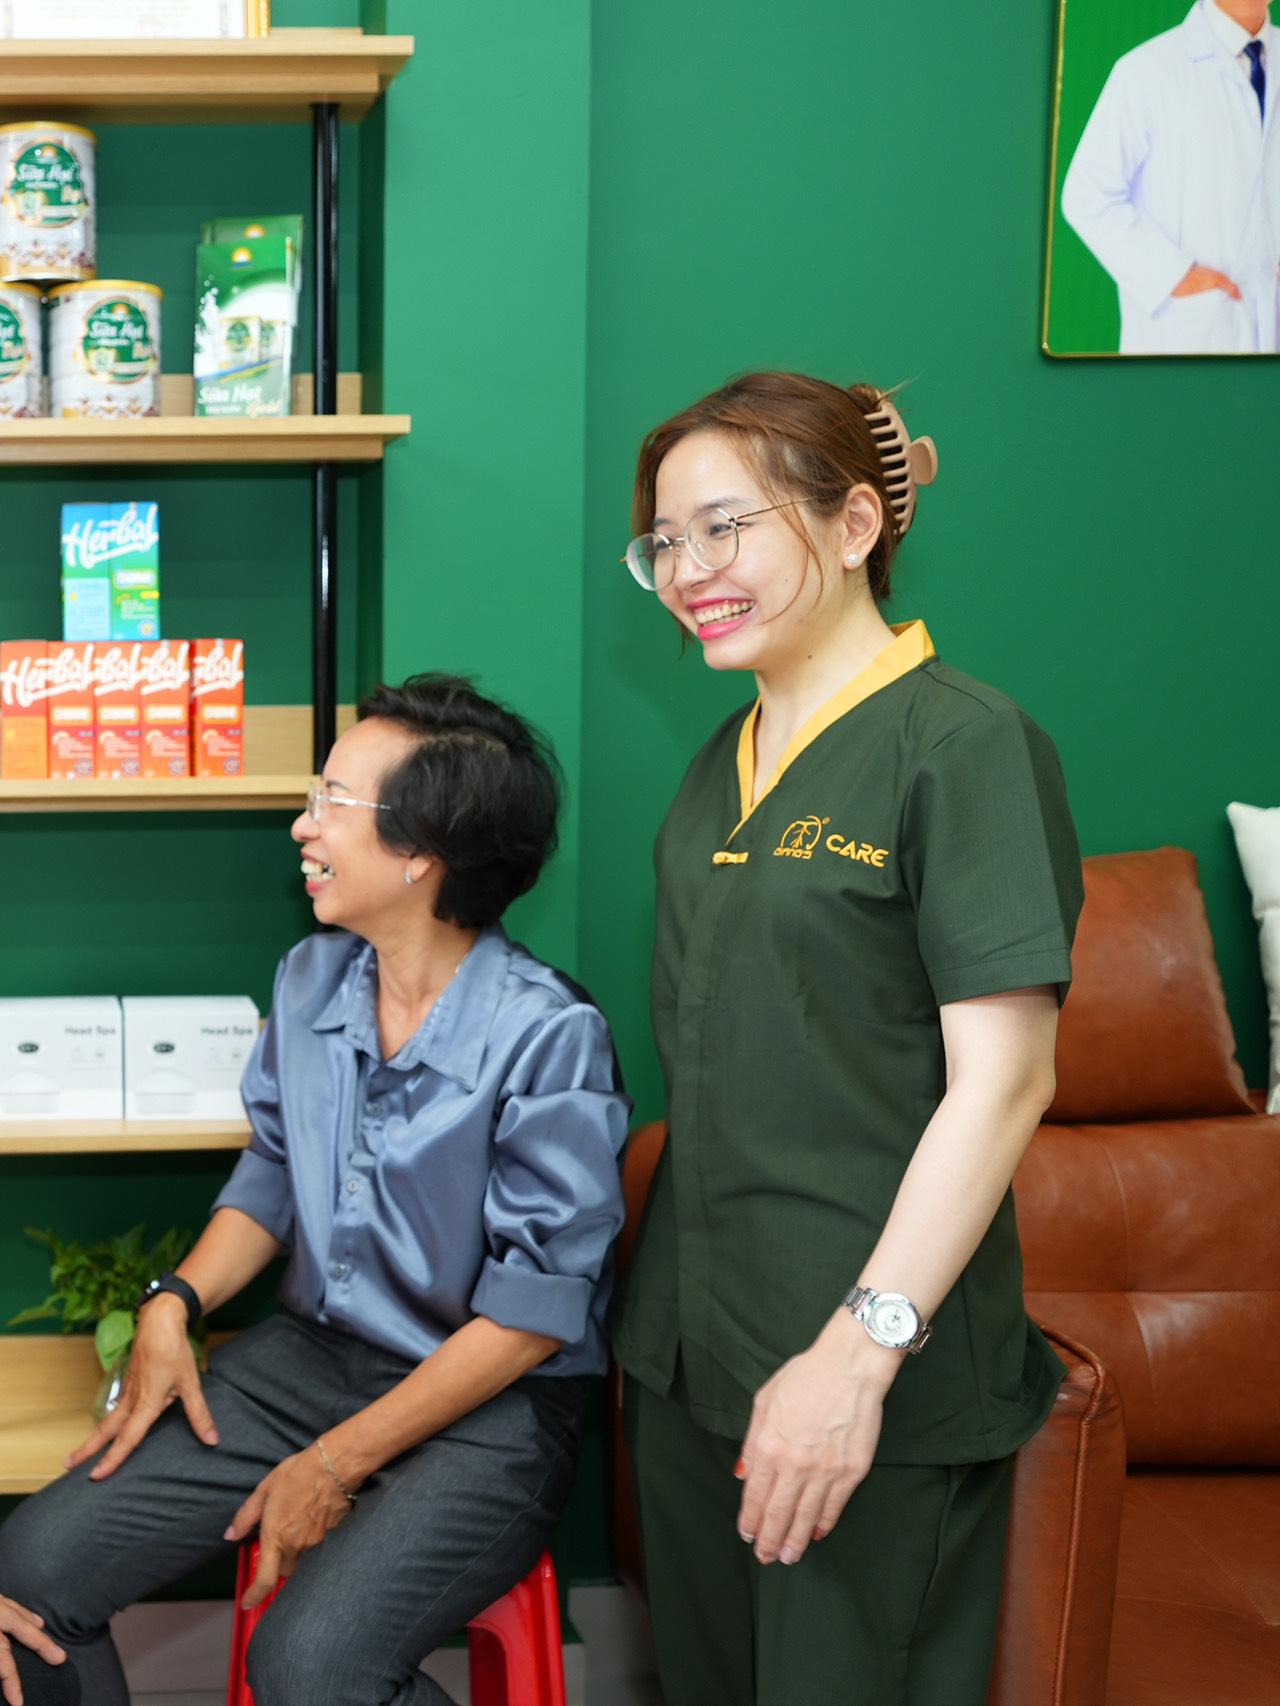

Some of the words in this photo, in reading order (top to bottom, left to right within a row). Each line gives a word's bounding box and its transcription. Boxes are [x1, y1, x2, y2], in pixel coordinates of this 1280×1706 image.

[62, 504, 158, 569] Herbal
[0, 643, 94, 708] Herbal
[826, 834, 889, 867] CARE
[64, 1025, 92, 1035] Head
[96, 1025, 116, 1037] Spa
[200, 1025, 228, 1035] Head
[232, 1025, 252, 1037] Spa
